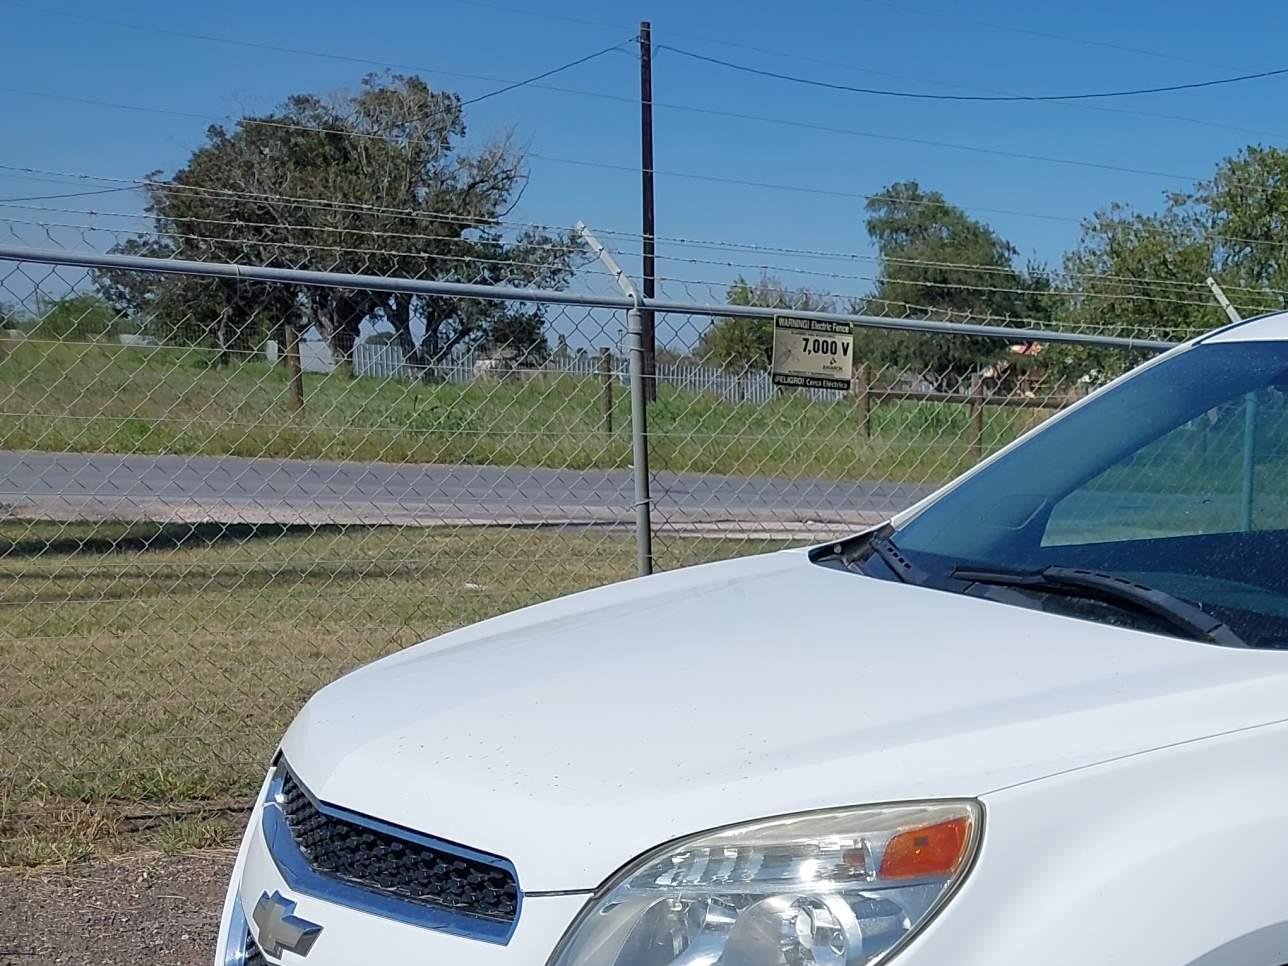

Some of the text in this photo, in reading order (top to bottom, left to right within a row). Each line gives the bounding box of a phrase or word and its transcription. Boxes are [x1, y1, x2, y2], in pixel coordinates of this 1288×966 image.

[779, 318, 849, 333] WARNING! Electric Fence
[803, 338, 850, 356] 7,000 V
